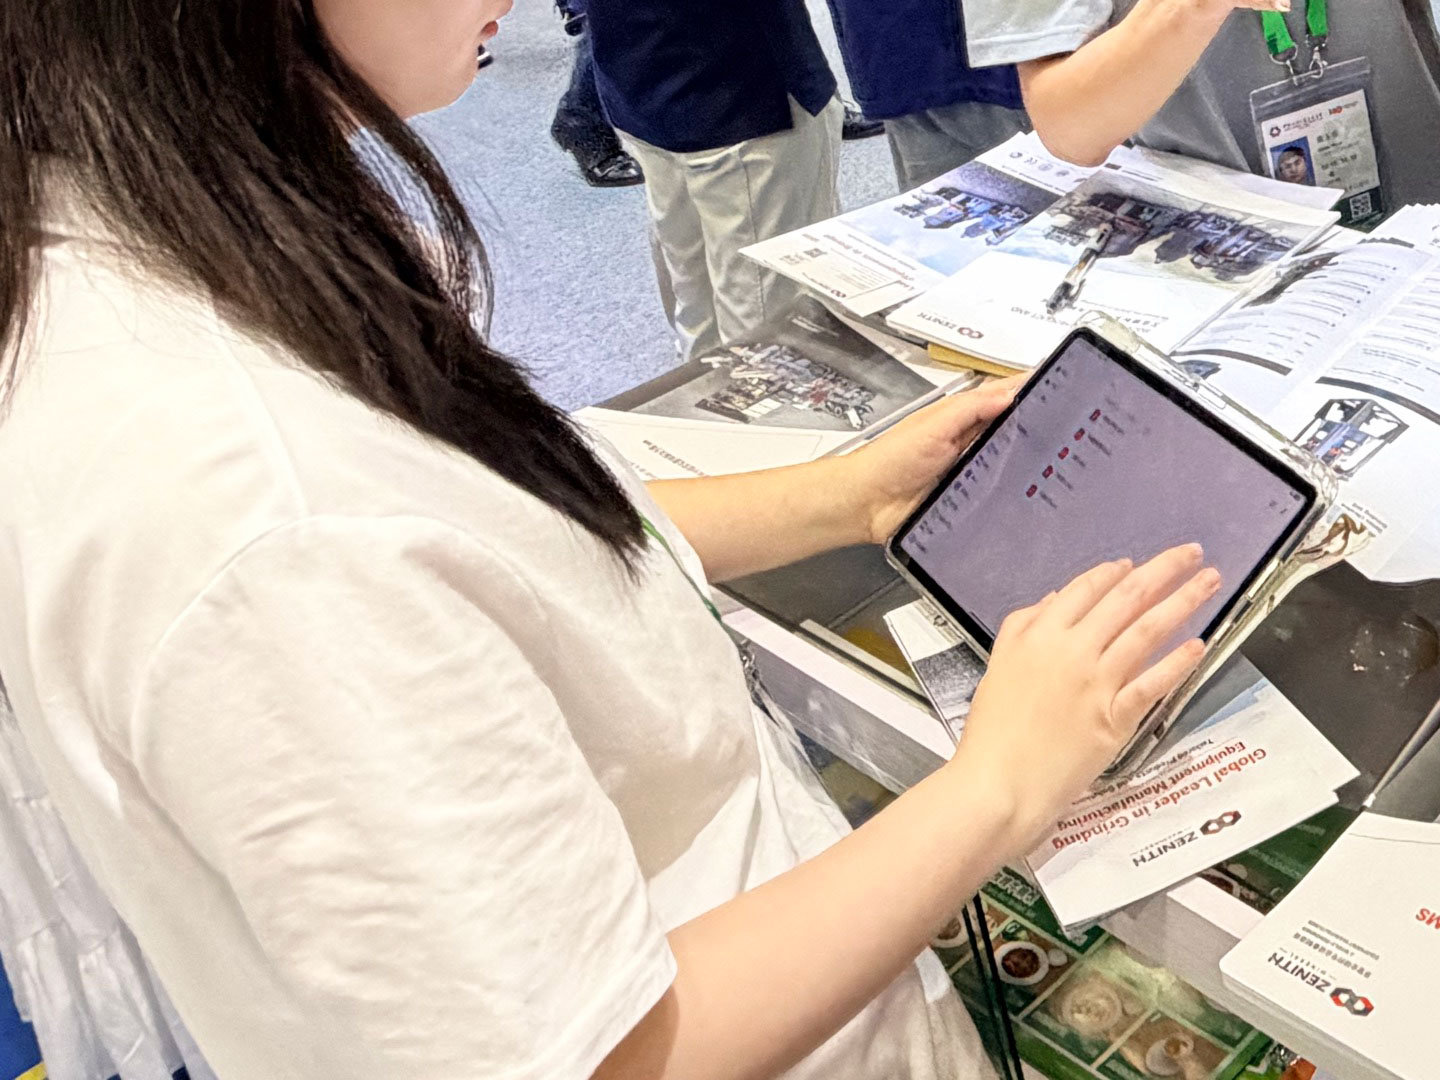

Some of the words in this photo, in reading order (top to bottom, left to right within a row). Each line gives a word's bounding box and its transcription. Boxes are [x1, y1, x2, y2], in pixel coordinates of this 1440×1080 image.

[1172, 740, 1246, 779] Equipment
[1213, 747, 1267, 783] Global
[1056, 781, 1169, 831] Manufacturing
[1153, 776, 1213, 810] Leader
[1132, 805, 1152, 819] in
[1051, 816, 1130, 851] Grinding
[1131, 830, 1200, 867] ZENITH
[1267, 951, 1332, 993] ZENITH
